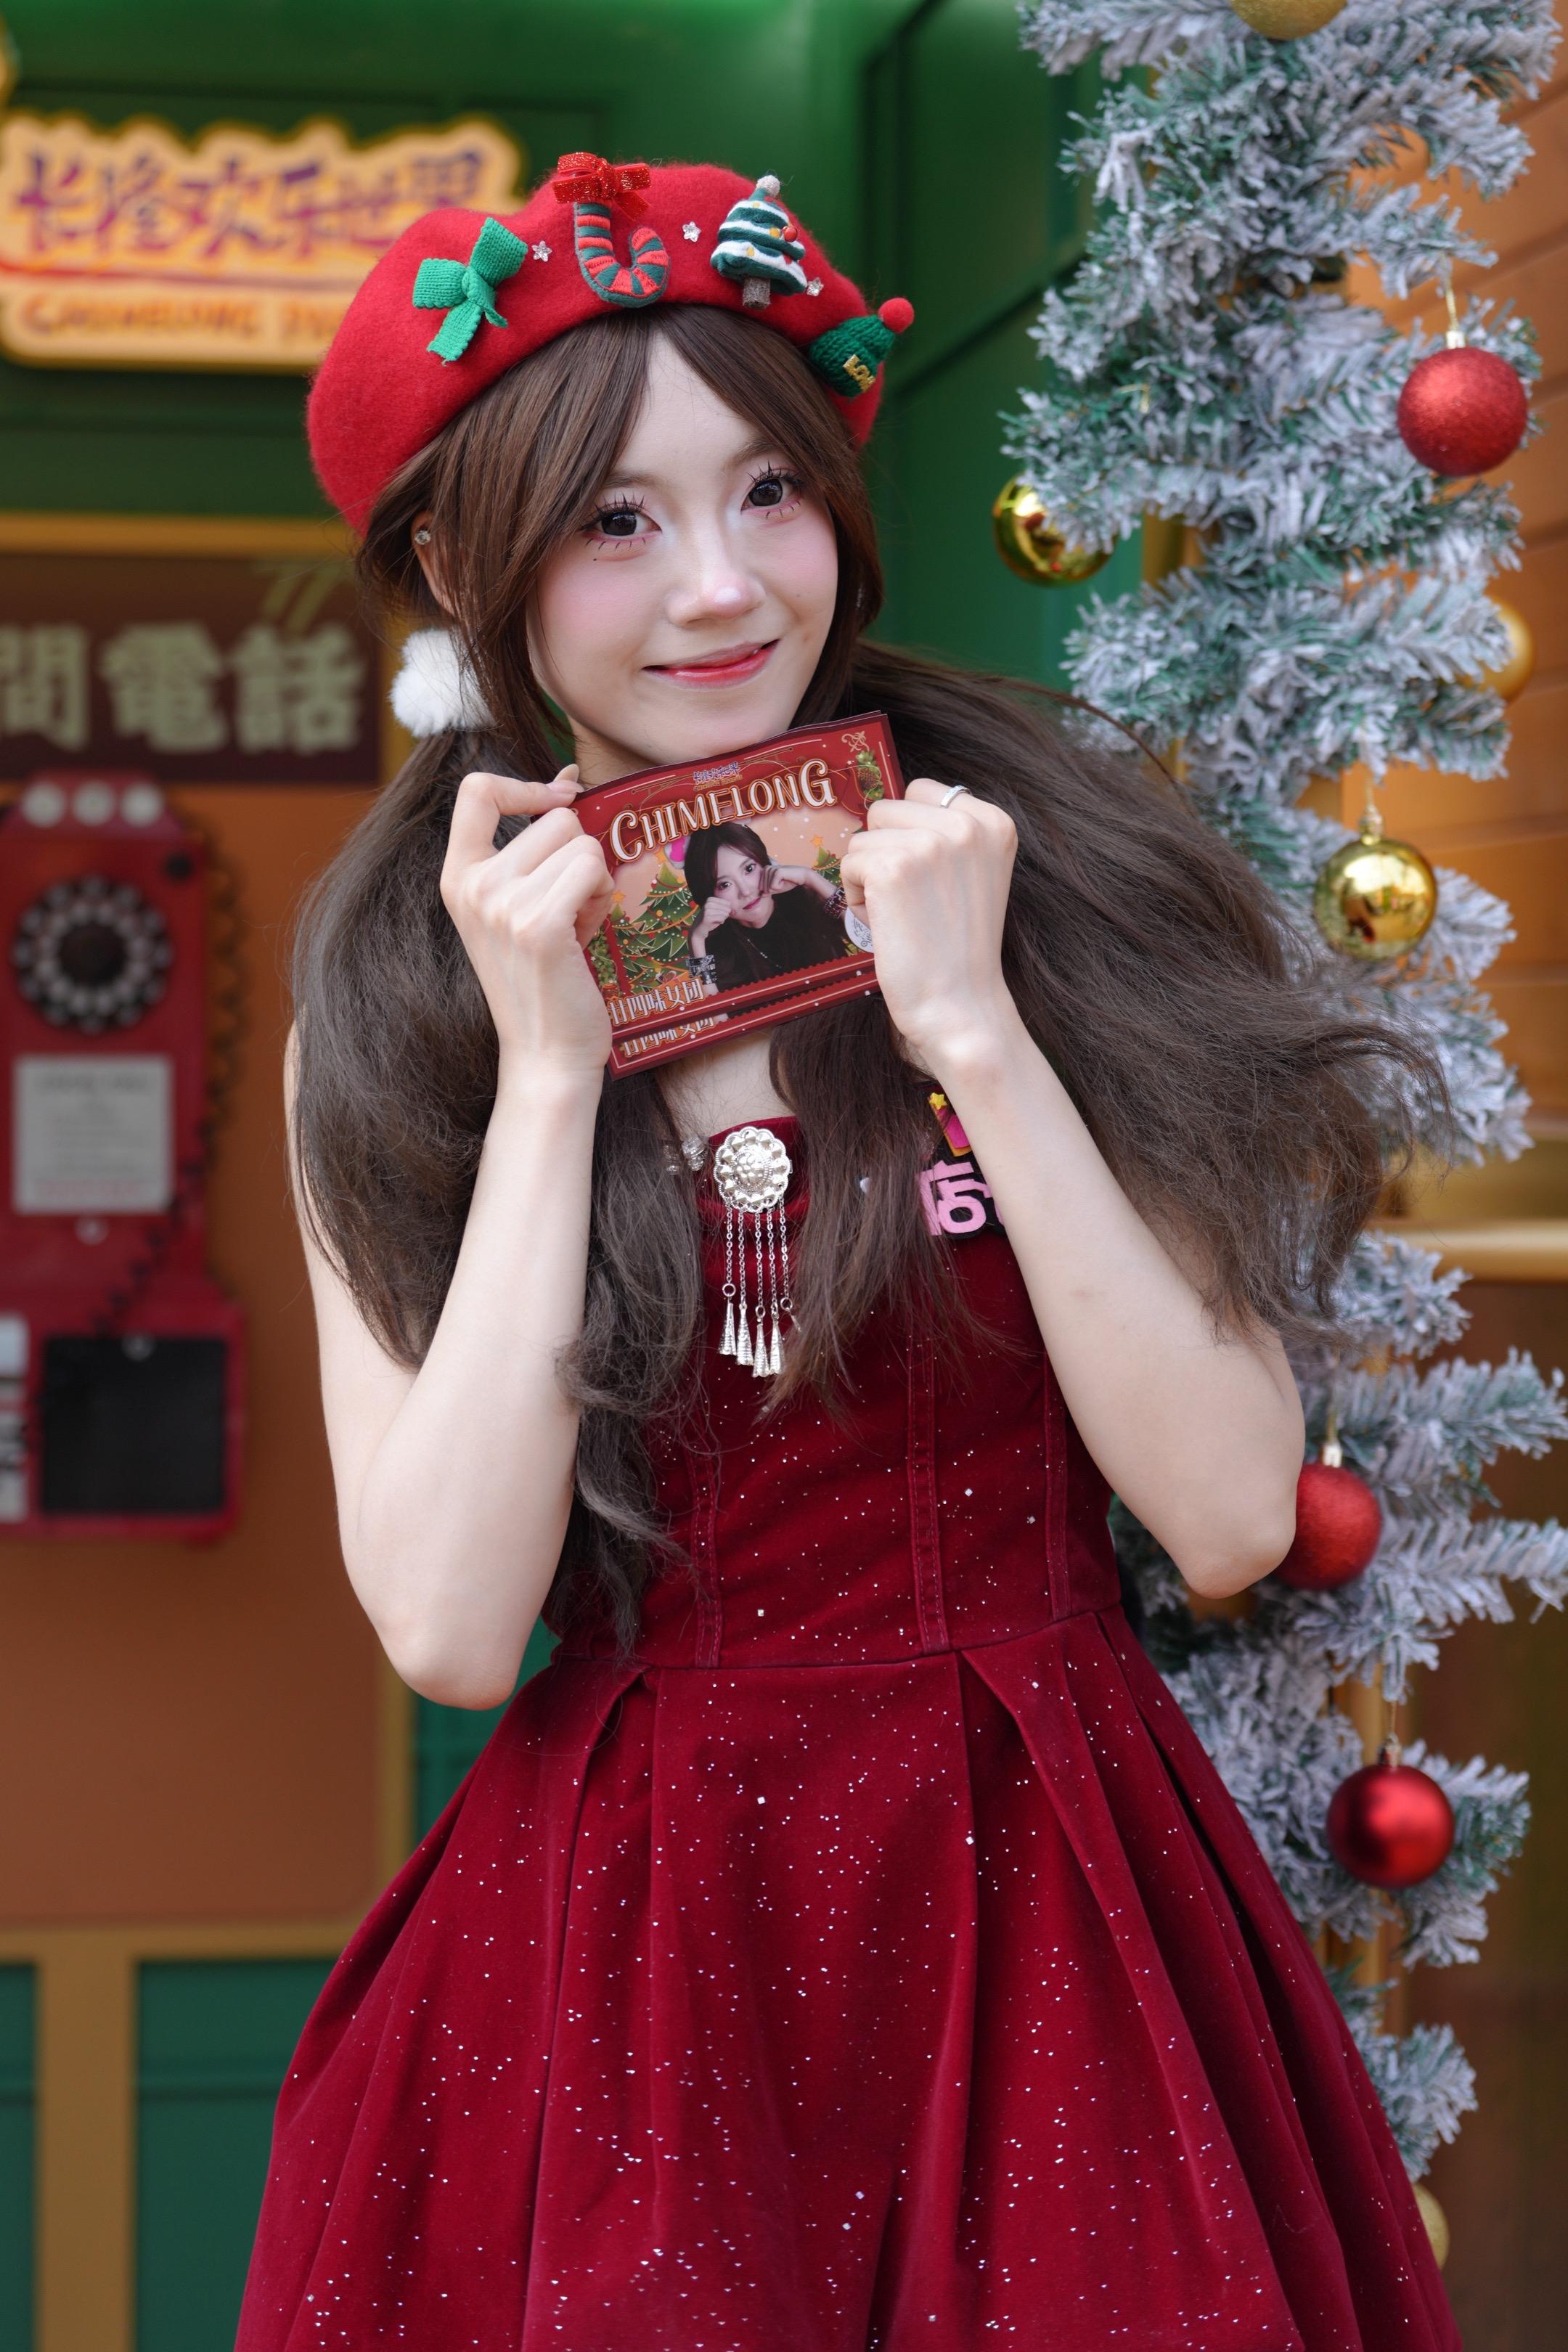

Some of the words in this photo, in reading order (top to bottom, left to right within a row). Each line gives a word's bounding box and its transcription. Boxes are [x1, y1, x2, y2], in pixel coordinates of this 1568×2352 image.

[609, 759, 837, 862] CHIMELONG
[608, 978, 704, 1026] 廿四味女团
